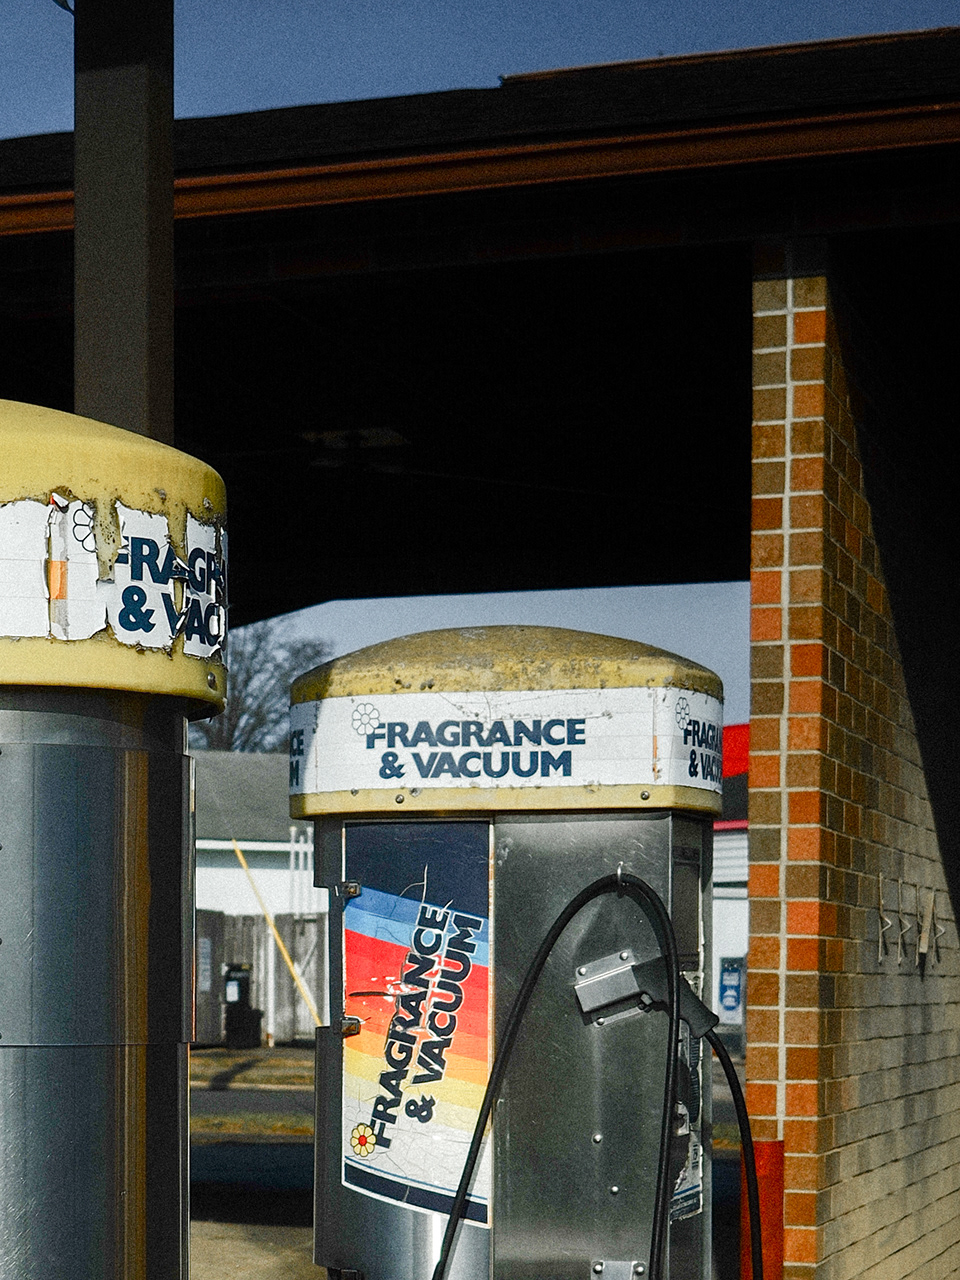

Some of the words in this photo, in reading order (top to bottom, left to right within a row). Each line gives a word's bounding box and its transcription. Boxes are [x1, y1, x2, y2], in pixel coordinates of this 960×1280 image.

[118, 585, 157, 633] &
[366, 718, 587, 749] FRAGRANCE
[379, 751, 406, 780] &
[411, 750, 572, 779] VACUUM
[688, 749, 699, 778] &
[410, 912, 483, 1085] VACUUM
[369, 904, 451, 1150] FRAGRANCE
[405, 1094, 436, 1124] &
